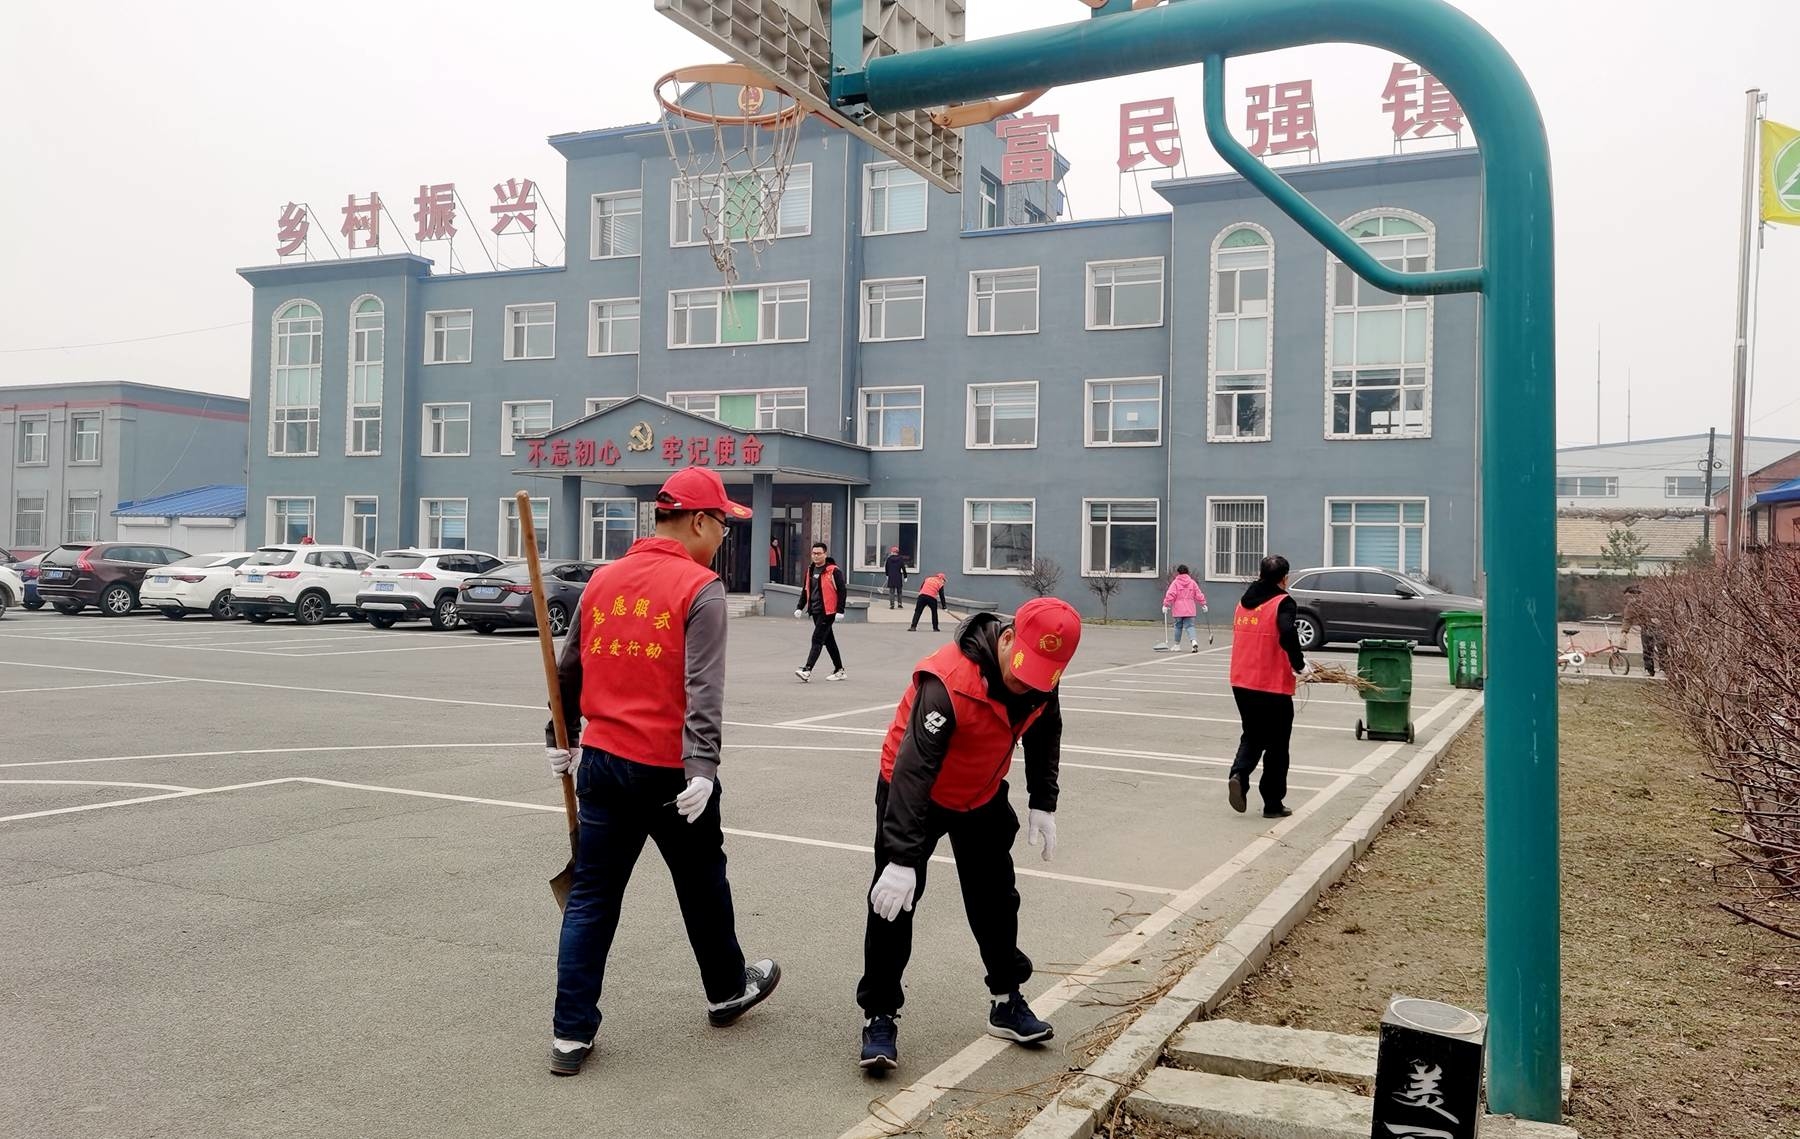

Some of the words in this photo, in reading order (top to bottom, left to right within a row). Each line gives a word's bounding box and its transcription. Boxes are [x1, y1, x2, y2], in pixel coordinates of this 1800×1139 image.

[995, 62, 1464, 185] 富民强镇
[276, 177, 537, 256] 乡村振兴
[527, 439, 621, 468] 不忘初心
[661, 434, 765, 466] 牢记使命
[590, 636, 663, 659] 关爱行动
